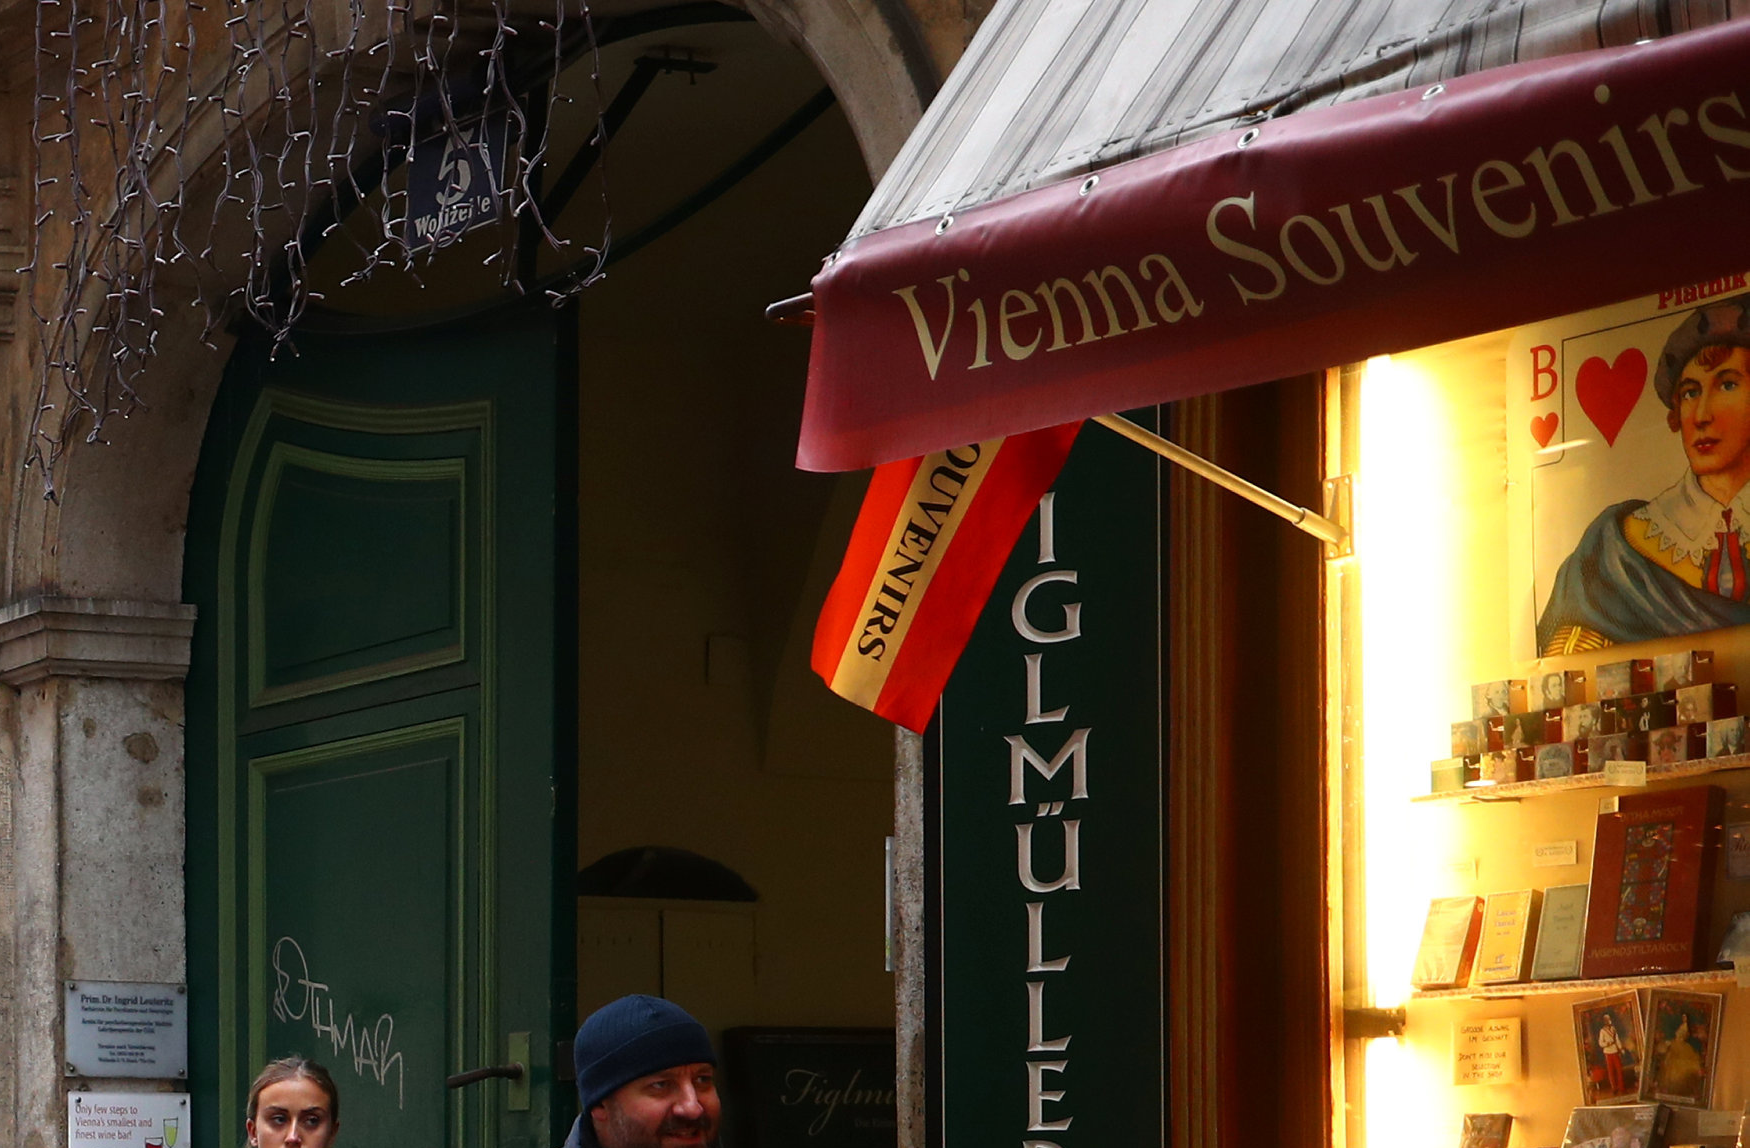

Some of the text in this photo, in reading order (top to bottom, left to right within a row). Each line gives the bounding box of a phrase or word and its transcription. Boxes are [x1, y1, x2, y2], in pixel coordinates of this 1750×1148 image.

[435, 127, 474, 205] 5
[892, 85, 1750, 382] Vienna Souvenirs
[1530, 345, 1558, 401] B
[857, 443, 981, 662] OUVENIRS
[75, 1103, 138, 1116] Only few steps to
[75, 1116, 153, 1127] Vienna's smallest and
[75, 1129, 96, 1139] finest
[98, 1130, 116, 1139] wine
